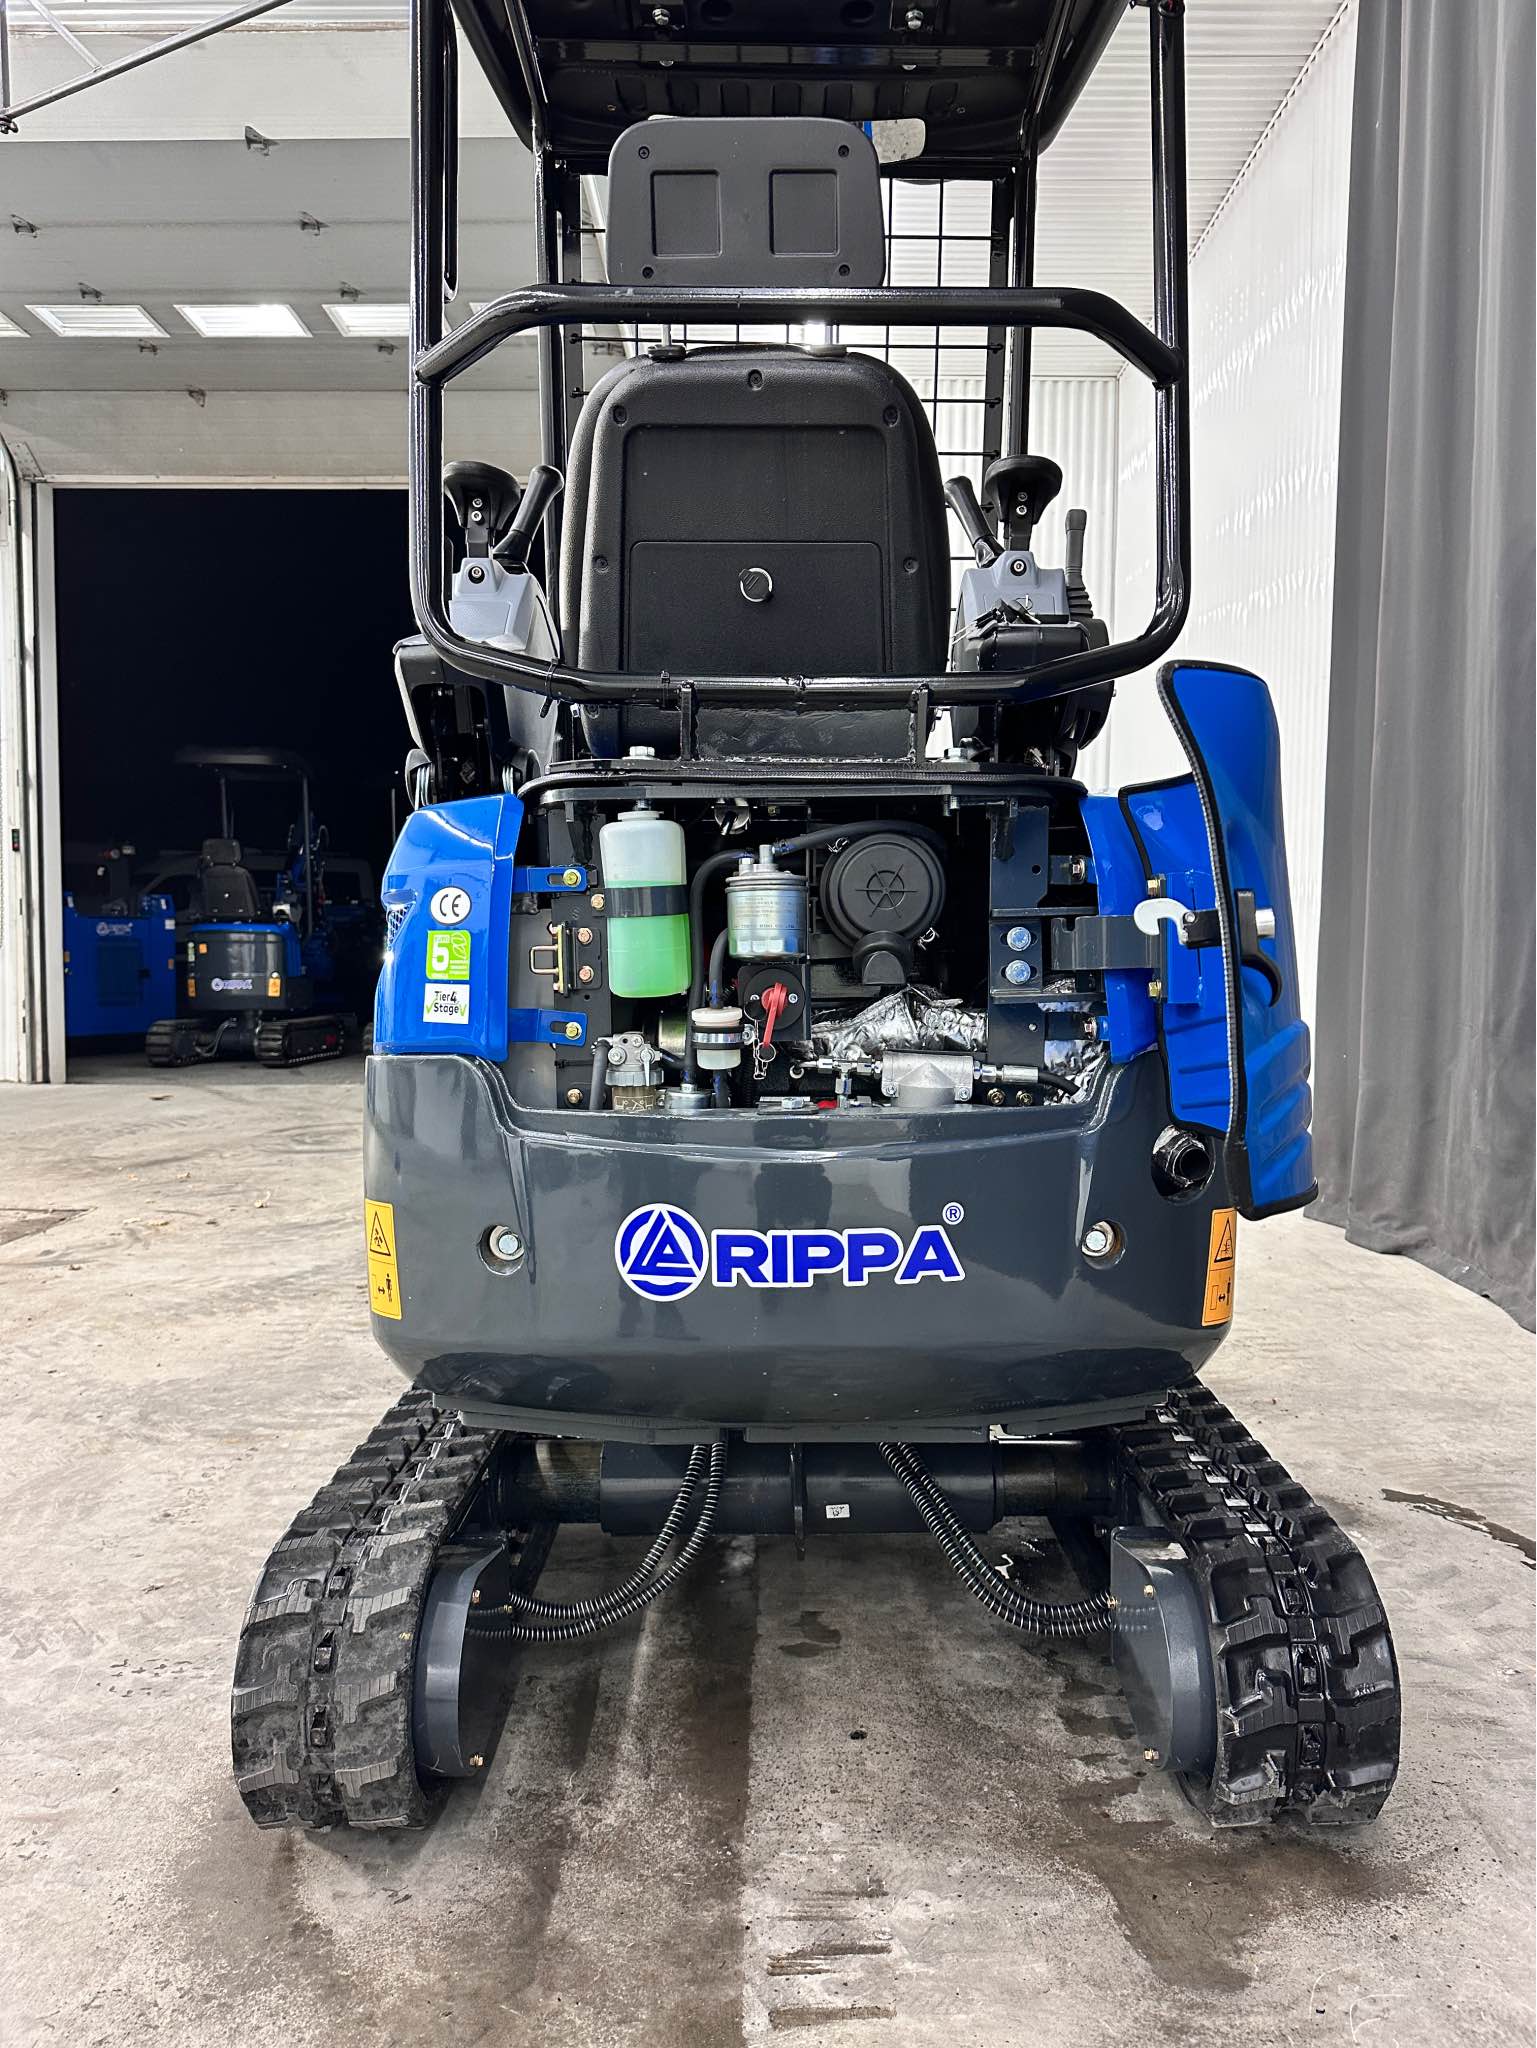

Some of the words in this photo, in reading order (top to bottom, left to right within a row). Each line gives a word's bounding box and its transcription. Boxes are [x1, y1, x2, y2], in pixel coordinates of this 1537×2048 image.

[440, 894, 461, 917] CE
[433, 1003, 459, 1016] Stage
[713, 1227, 963, 1285] RIPPA
